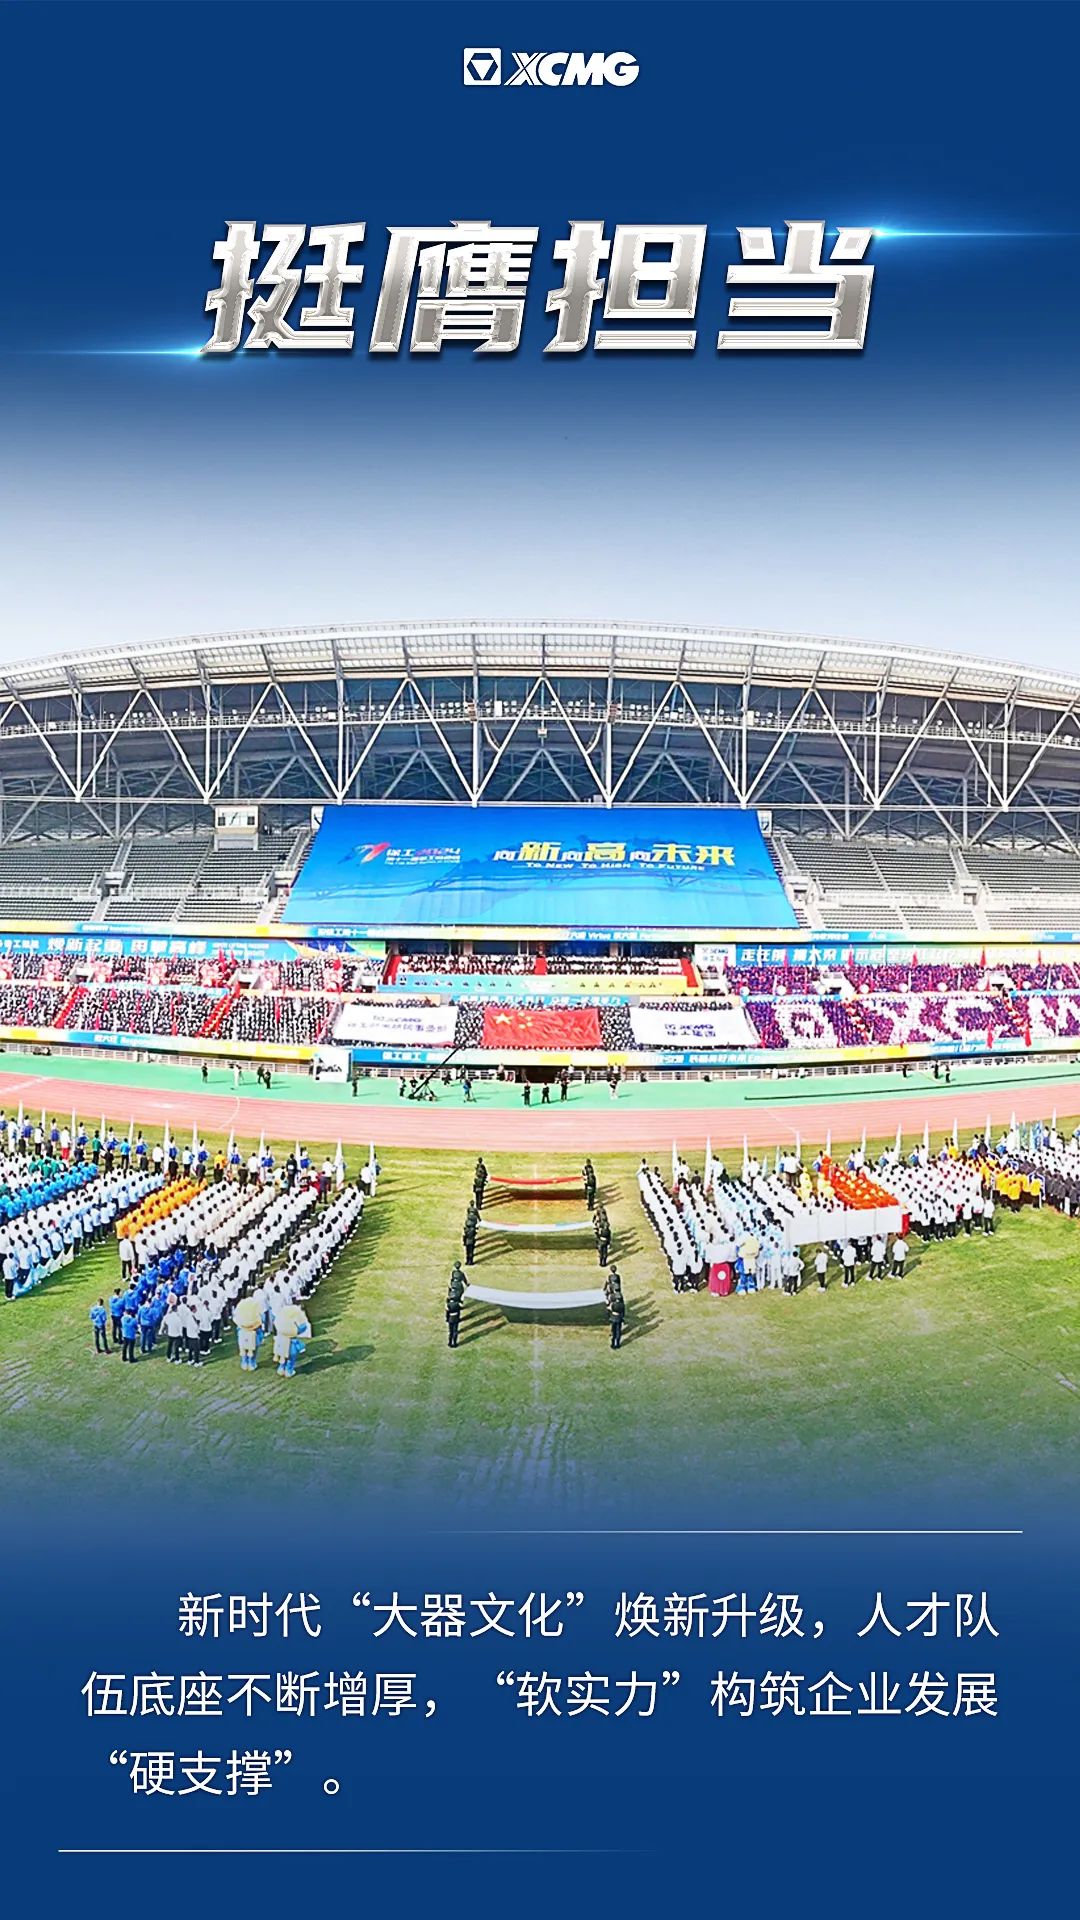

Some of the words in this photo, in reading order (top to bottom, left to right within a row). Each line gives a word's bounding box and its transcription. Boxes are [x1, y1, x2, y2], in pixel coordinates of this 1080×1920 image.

[493, 841, 736, 866] 向新向高向未来
